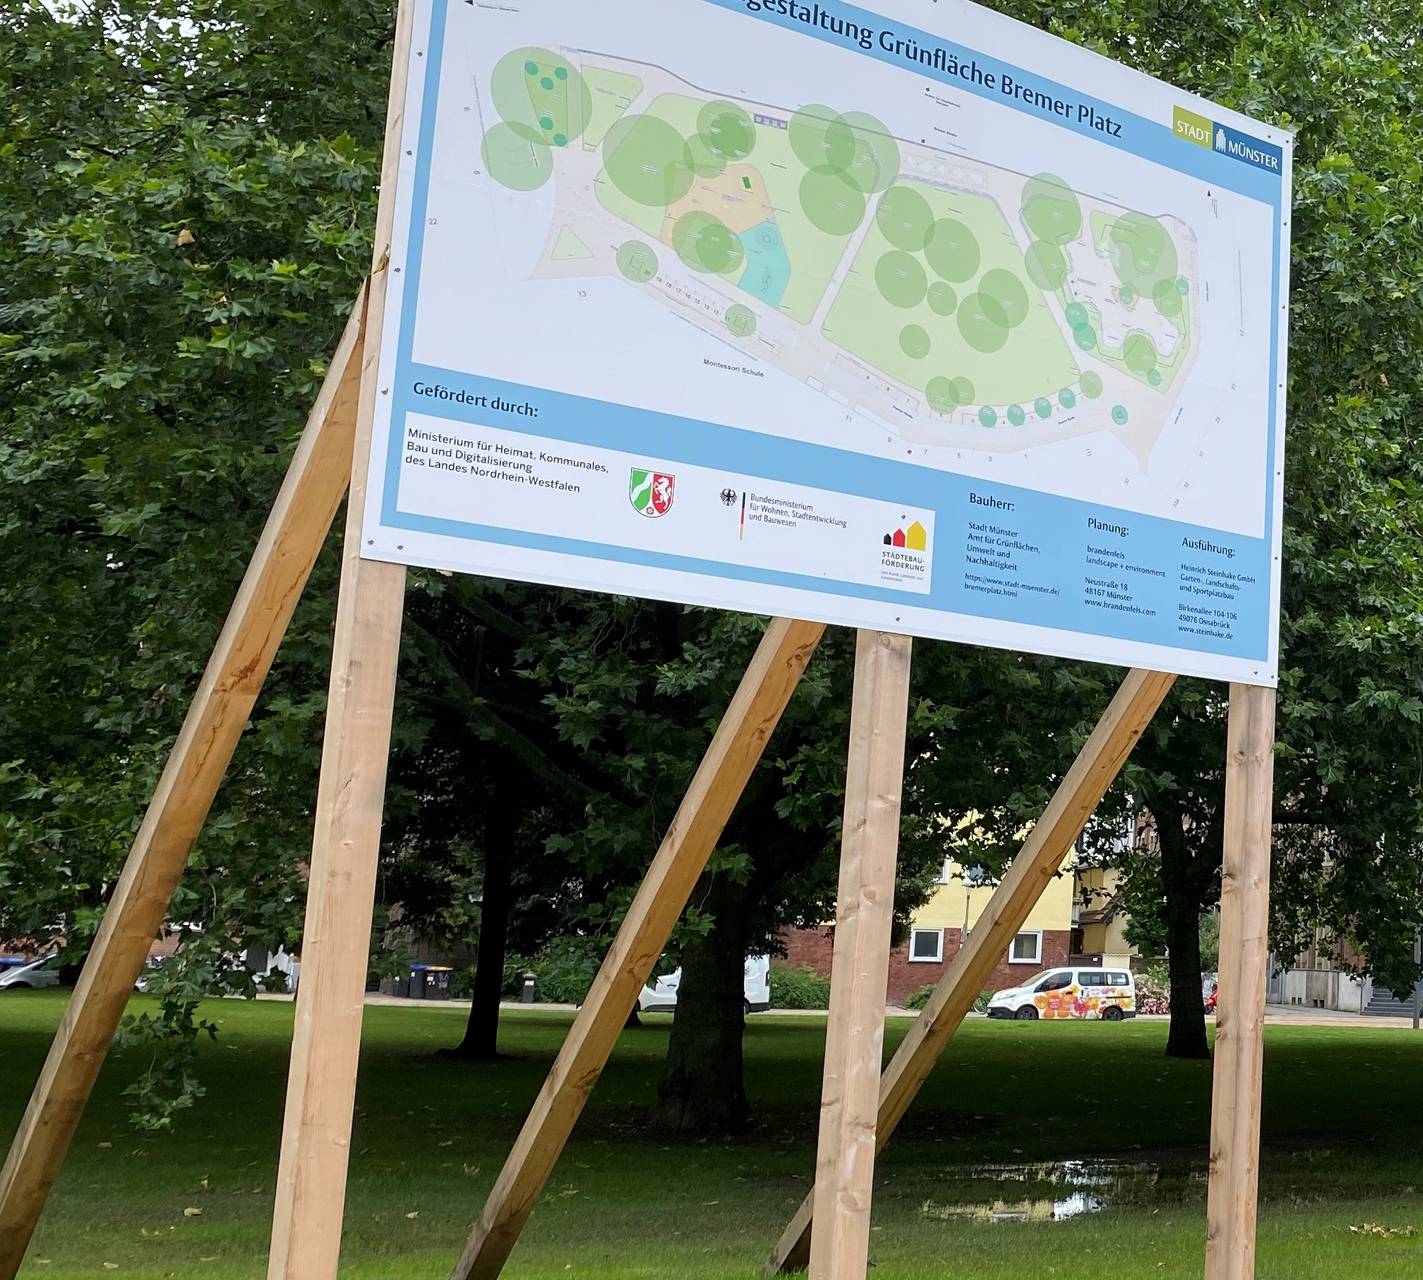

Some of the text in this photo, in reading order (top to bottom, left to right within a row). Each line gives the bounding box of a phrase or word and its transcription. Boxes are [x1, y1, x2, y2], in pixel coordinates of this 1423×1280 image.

[742, 0, 1123, 139] gestaltung Grünfläche Bremer Platz
[1177, 119, 1279, 170] STADT MÜNSTER
[413, 381, 539, 418] Gefördert durch:
[407, 441, 533, 474] Bau und Digitalisierung
[408, 428, 609, 474] Ministerium für Heimat, Kommunales,
[405, 455, 581, 493] des Landes Nordrhein-Westfalen
[750, 493, 814, 512] Bundesministerium
[969, 492, 1015, 511] Bauherr:
[748, 514, 797, 528] und Bauwesen
[749, 503, 760, 511] für
[791, 510, 848, 529] Stadtentwicklung
[968, 521, 1019, 538] Stadt Münster
[1088, 517, 1130, 538] Planung:
[967, 532, 984, 543] Amt
[984, 535, 995, 545] für
[1181, 537, 1236, 558] Ausführung:
[966, 544, 1011, 559] Umwelt und
[965, 555, 1018, 571] Nachhaltigkeit
[1180, 563, 1207, 574] Heinrich
[1106, 591, 1133, 601] Münster
[1179, 584, 1192, 592] und
